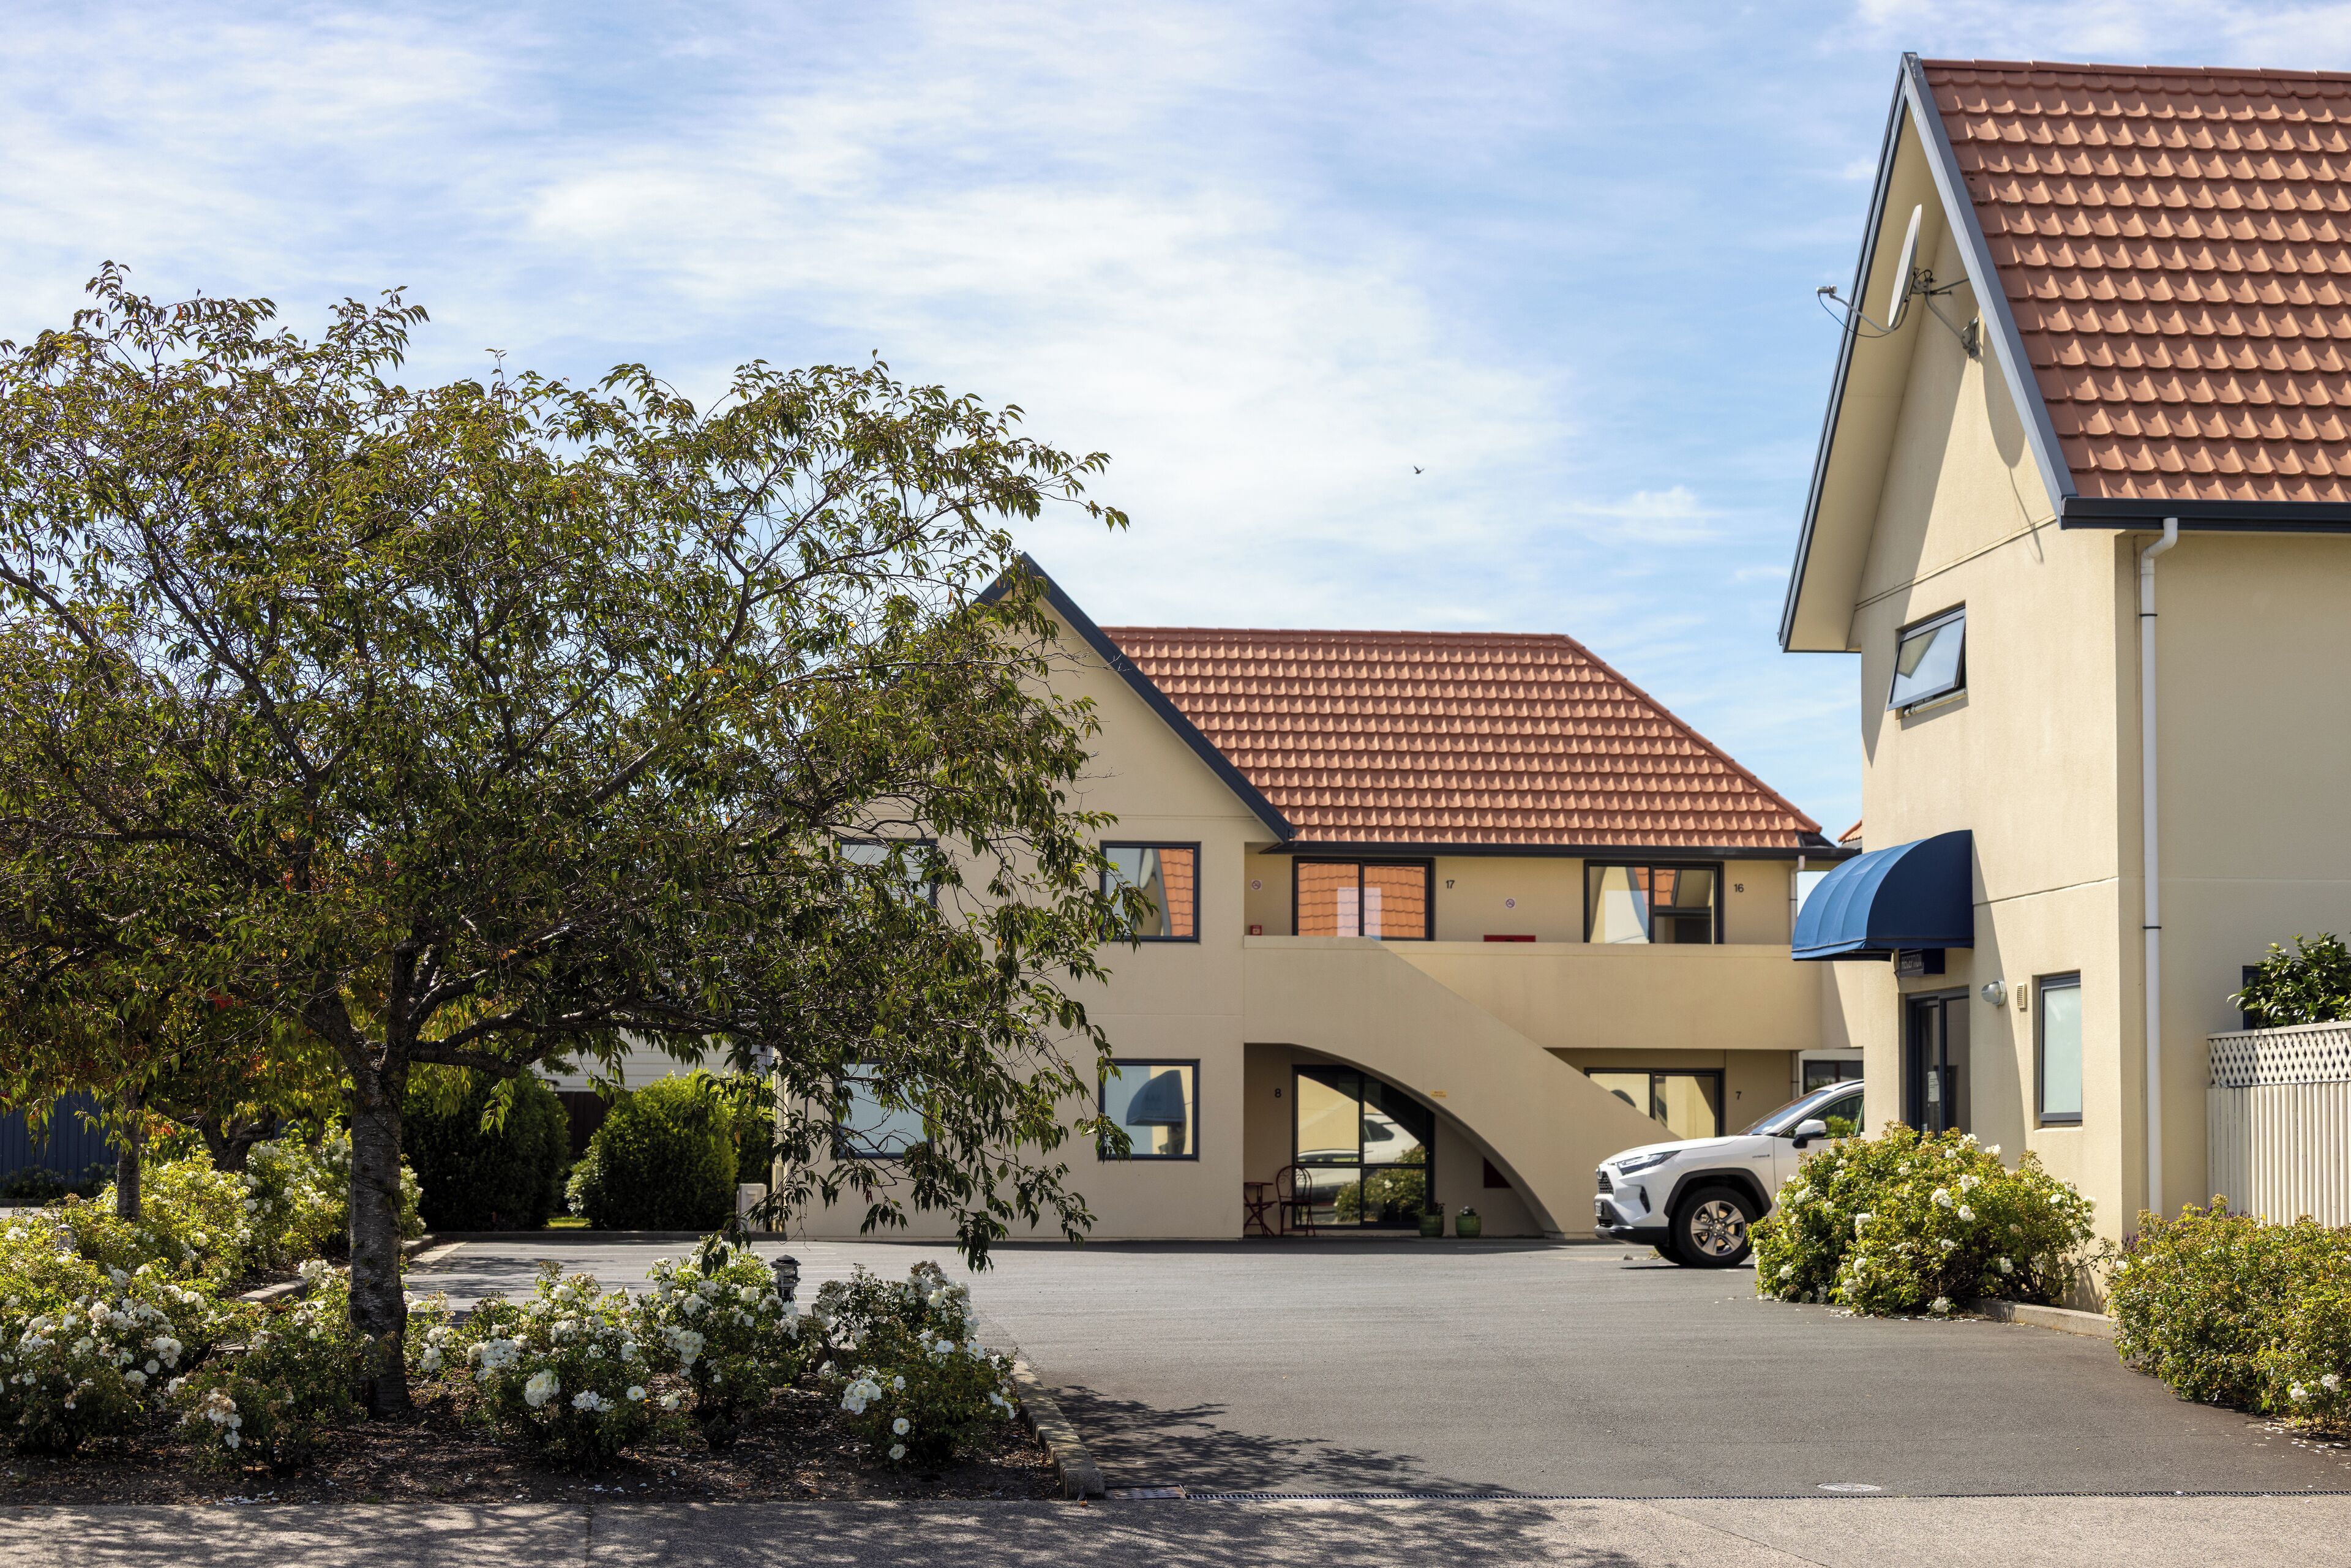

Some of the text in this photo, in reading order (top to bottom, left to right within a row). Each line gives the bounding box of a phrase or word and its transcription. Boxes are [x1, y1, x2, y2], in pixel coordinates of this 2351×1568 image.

[1445, 880, 1455, 888] 17
[1734, 883, 1744, 893] 16
[1901, 953, 1922, 970] RECEPTION
[1275, 1088, 1281, 1098] 8
[1736, 1091, 1742, 1100] 7
